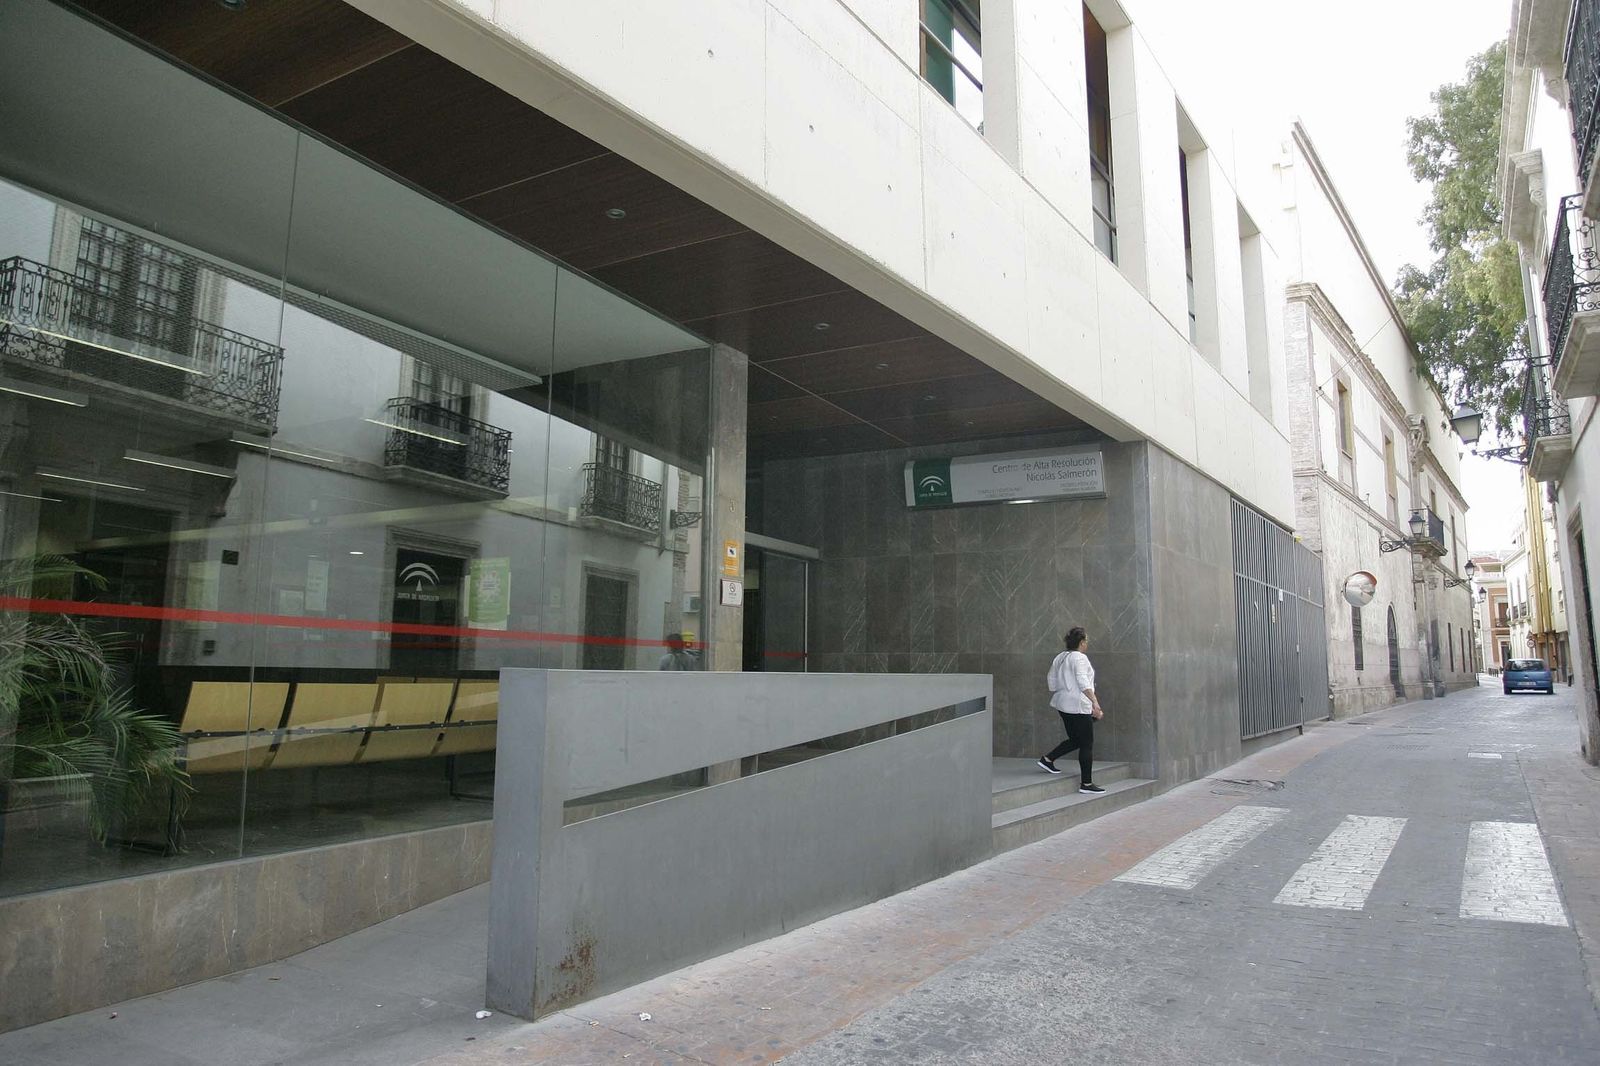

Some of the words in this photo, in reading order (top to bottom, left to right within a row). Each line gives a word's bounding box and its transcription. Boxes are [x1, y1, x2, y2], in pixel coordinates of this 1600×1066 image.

[1034, 460, 1050, 470] Alta
[1051, 456, 1096, 469] Resolución
[1026, 471, 1056, 481] Nicolás
[1057, 468, 1097, 480] Salmerón
